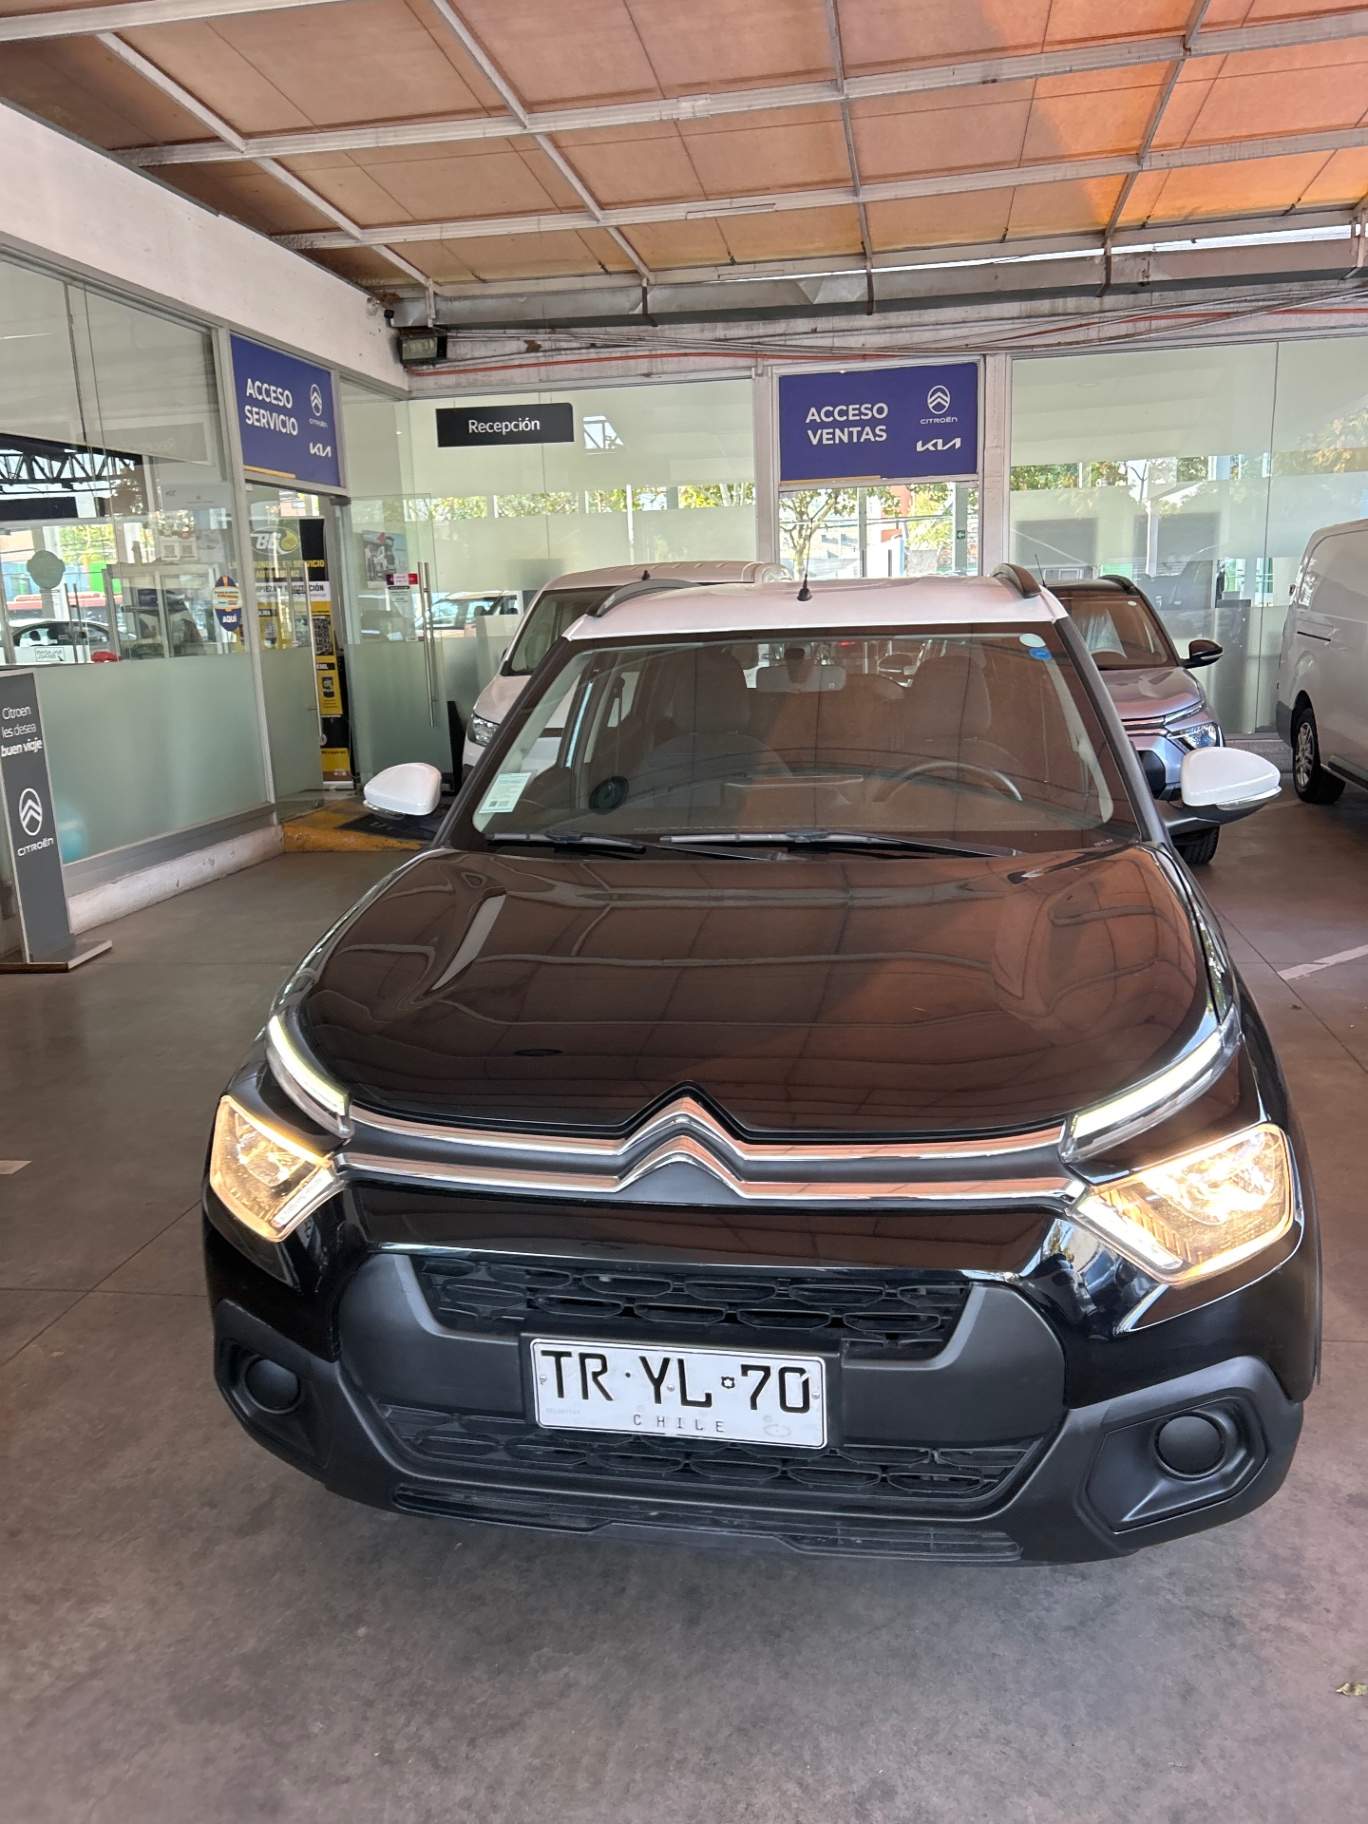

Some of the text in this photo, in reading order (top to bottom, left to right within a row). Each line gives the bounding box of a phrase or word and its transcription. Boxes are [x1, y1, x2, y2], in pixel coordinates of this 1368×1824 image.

[246, 378, 293, 409] ACCESO
[244, 405, 298, 436] SERVICIO
[805, 402, 889, 424] ACCESO
[468, 417, 541, 435] Recepción
[807, 425, 888, 446] VENTAS
[309, 441, 332, 457] KIA
[916, 437, 962, 452] KIA
[1, 737, 43, 757] buen viaje
[632, 1413, 726, 1433] CHILE
